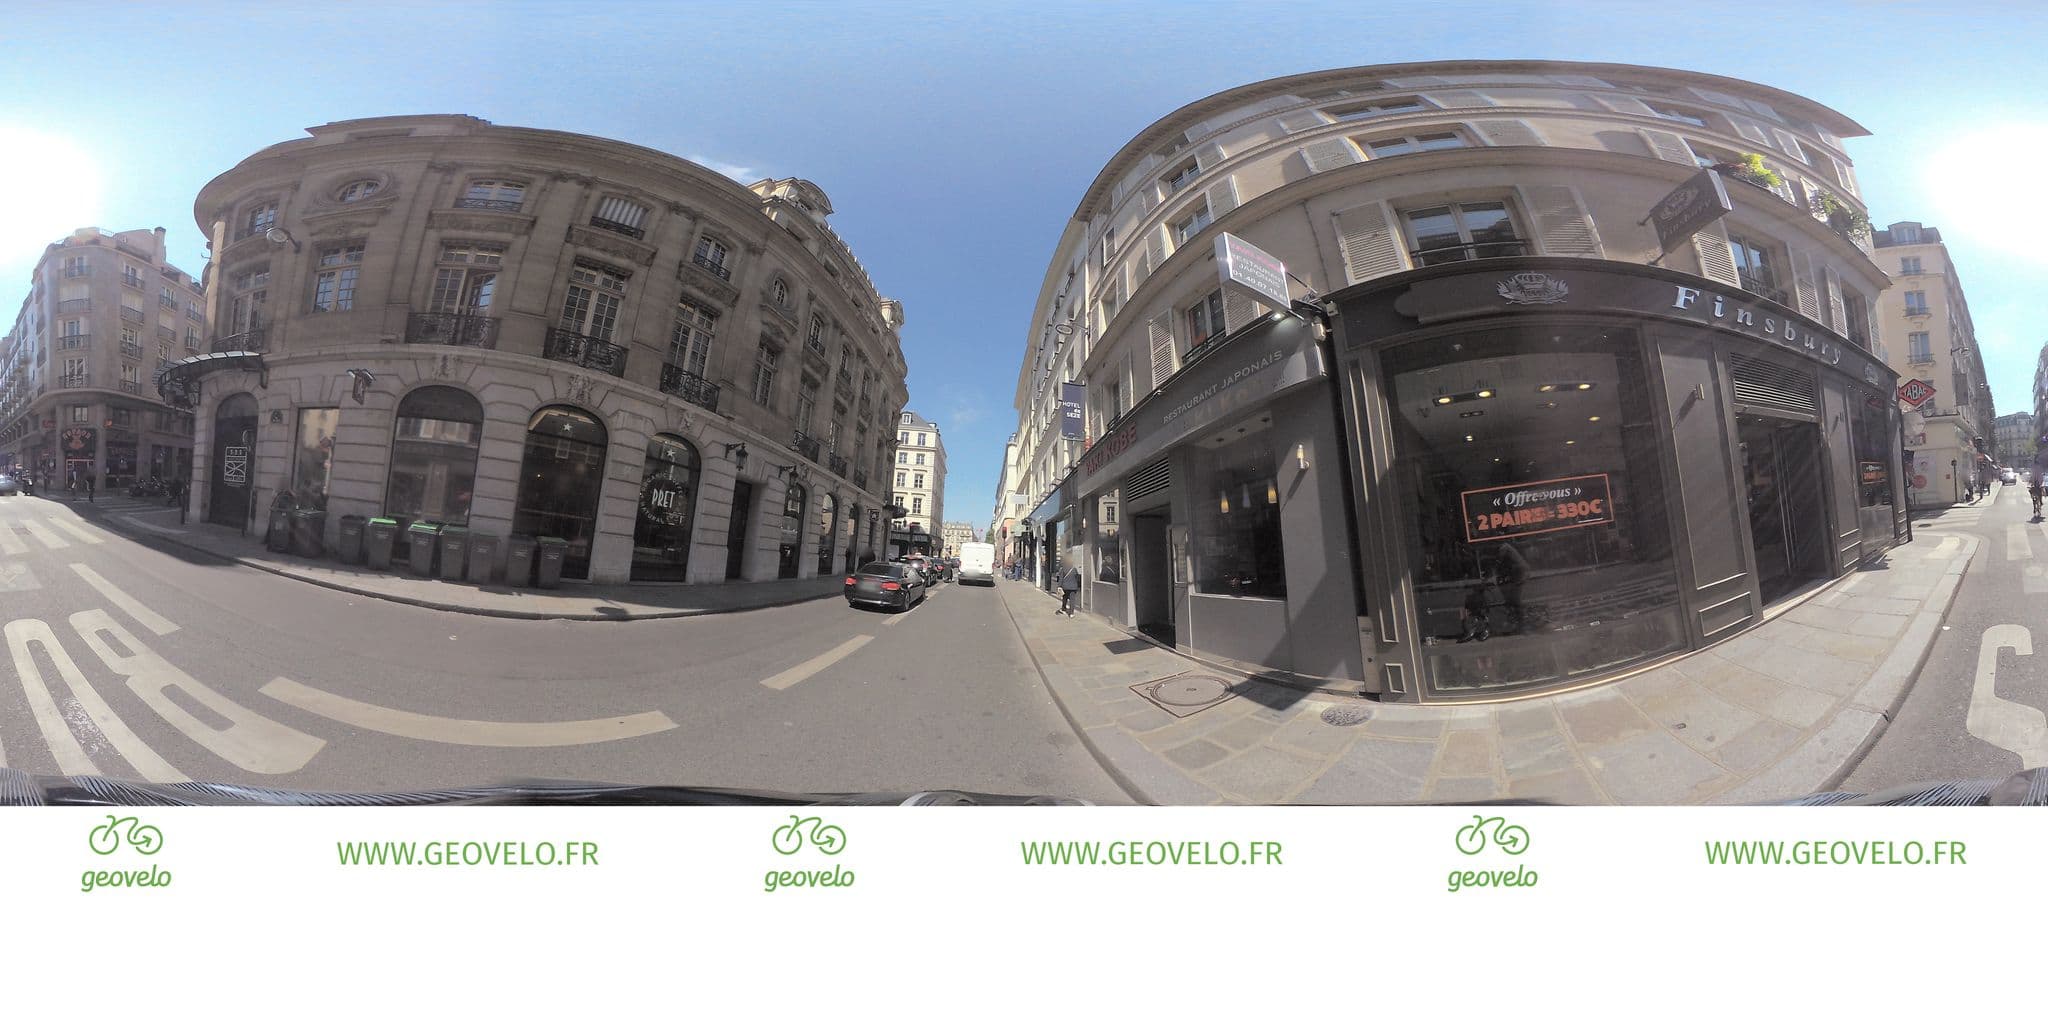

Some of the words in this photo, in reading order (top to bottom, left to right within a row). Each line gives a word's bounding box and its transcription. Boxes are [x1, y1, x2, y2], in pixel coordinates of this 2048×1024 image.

[1671, 285, 1842, 365] Finsbury
[1162, 383, 1218, 424] RESTAURANT
[1221, 350, 1283, 388] JAPONAIS
[1904, 384, 1926, 400] TABAC
[1062, 401, 1081, 409] HOTEL
[651, 488, 676, 509] PRET
[1477, 514, 1489, 531] 2
